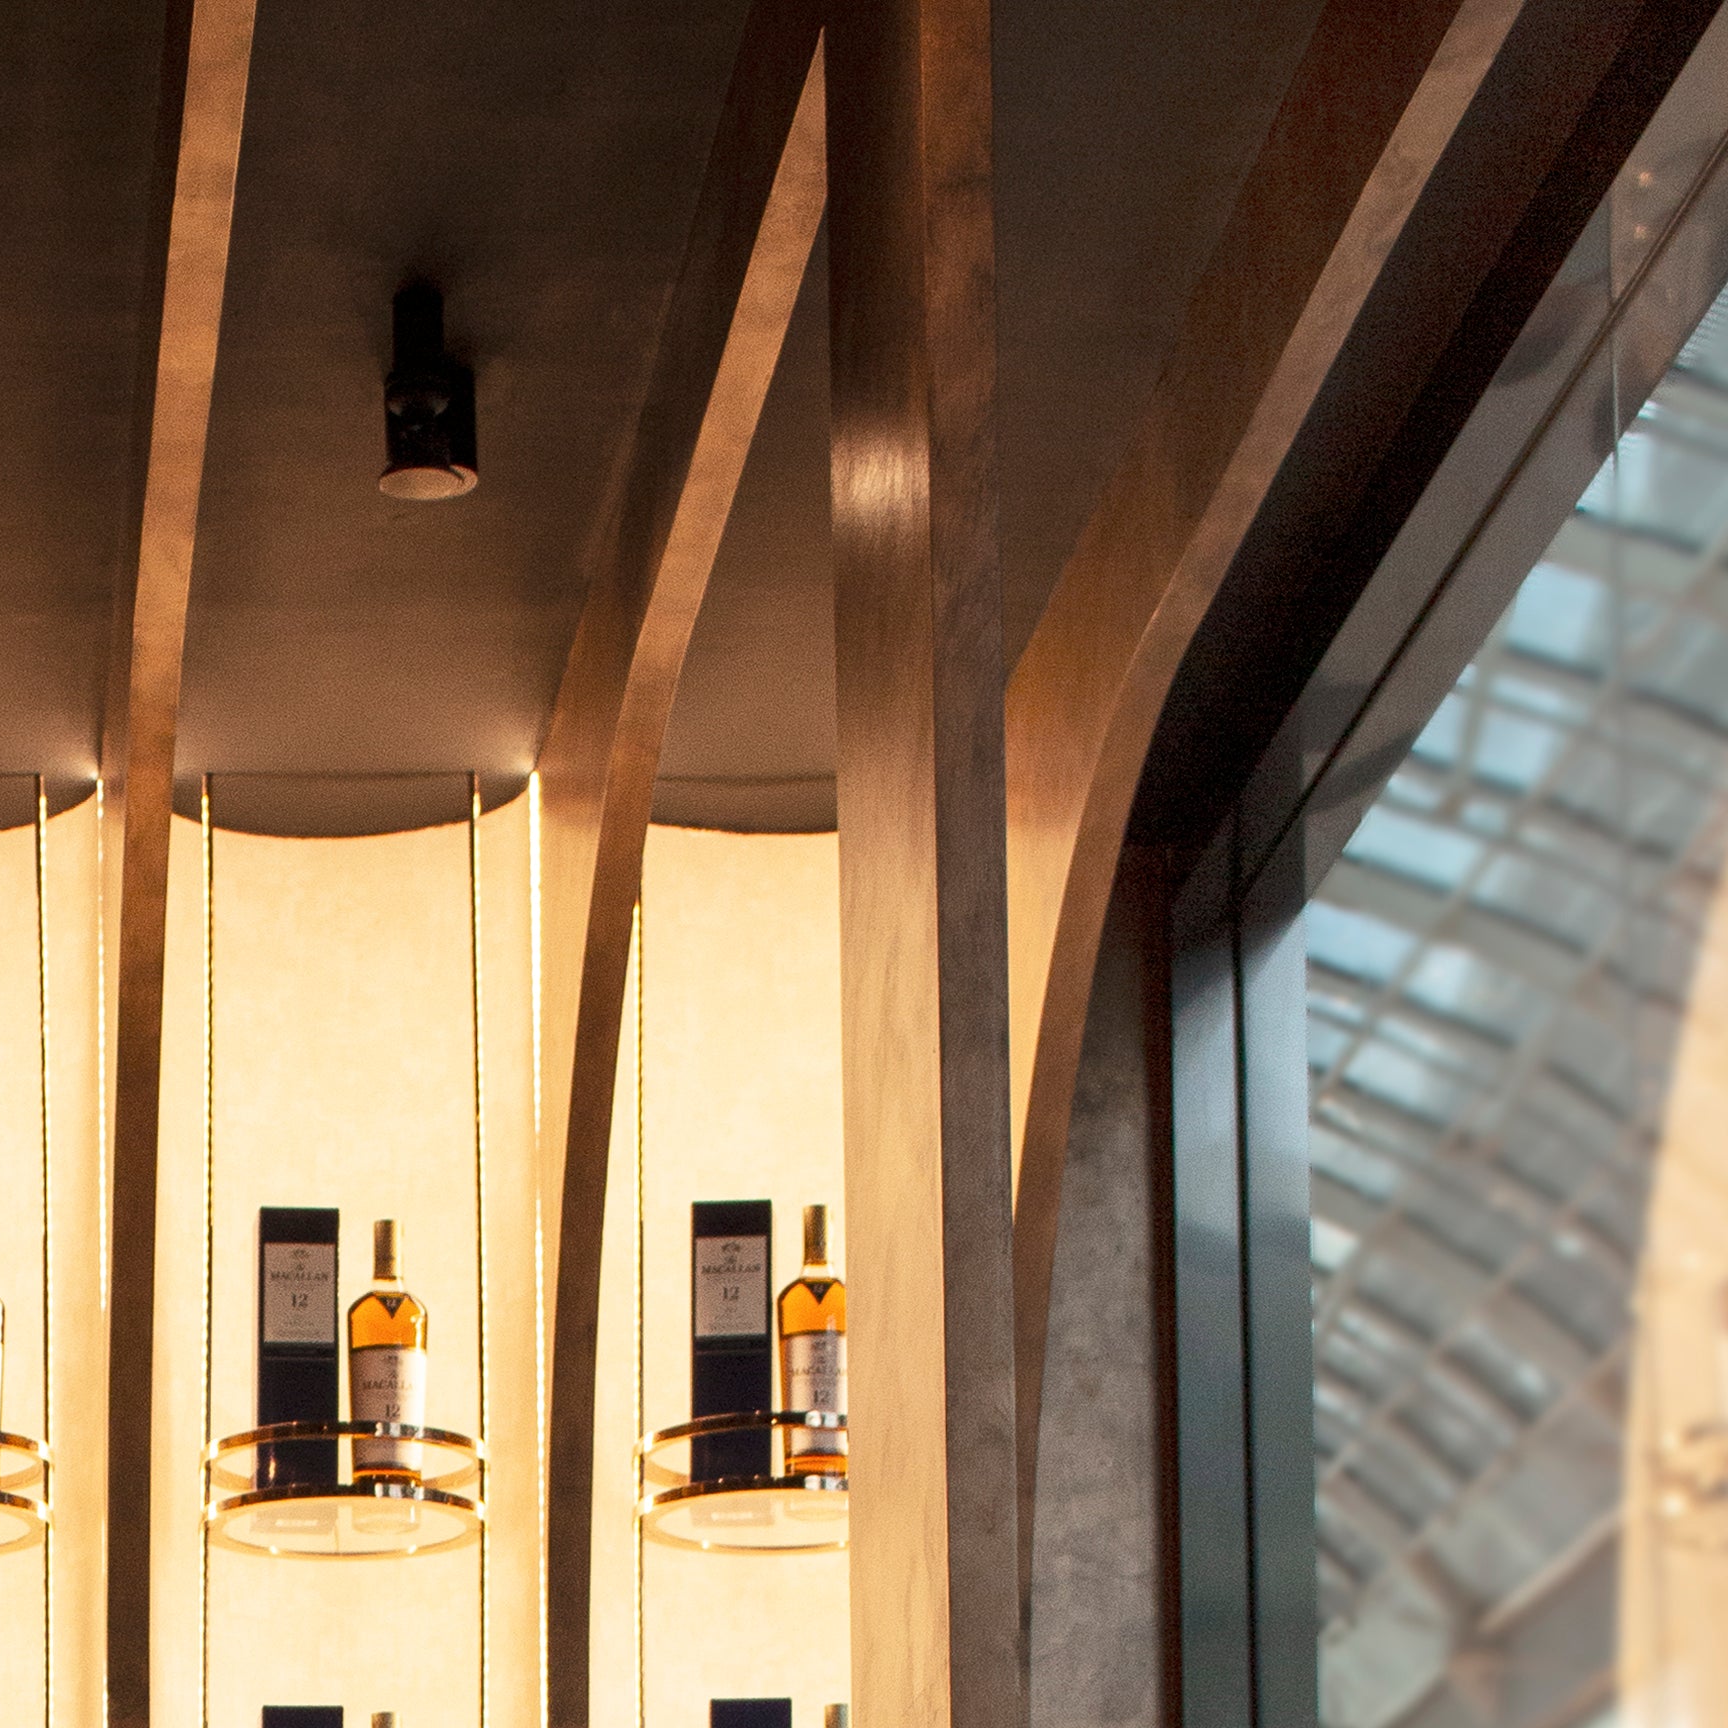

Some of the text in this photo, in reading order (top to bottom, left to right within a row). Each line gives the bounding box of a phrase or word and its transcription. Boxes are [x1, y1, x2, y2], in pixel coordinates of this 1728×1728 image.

[291, 1293, 308, 1308] 12
[723, 1286, 740, 1301] 12
[385, 1405, 401, 1418] 12
